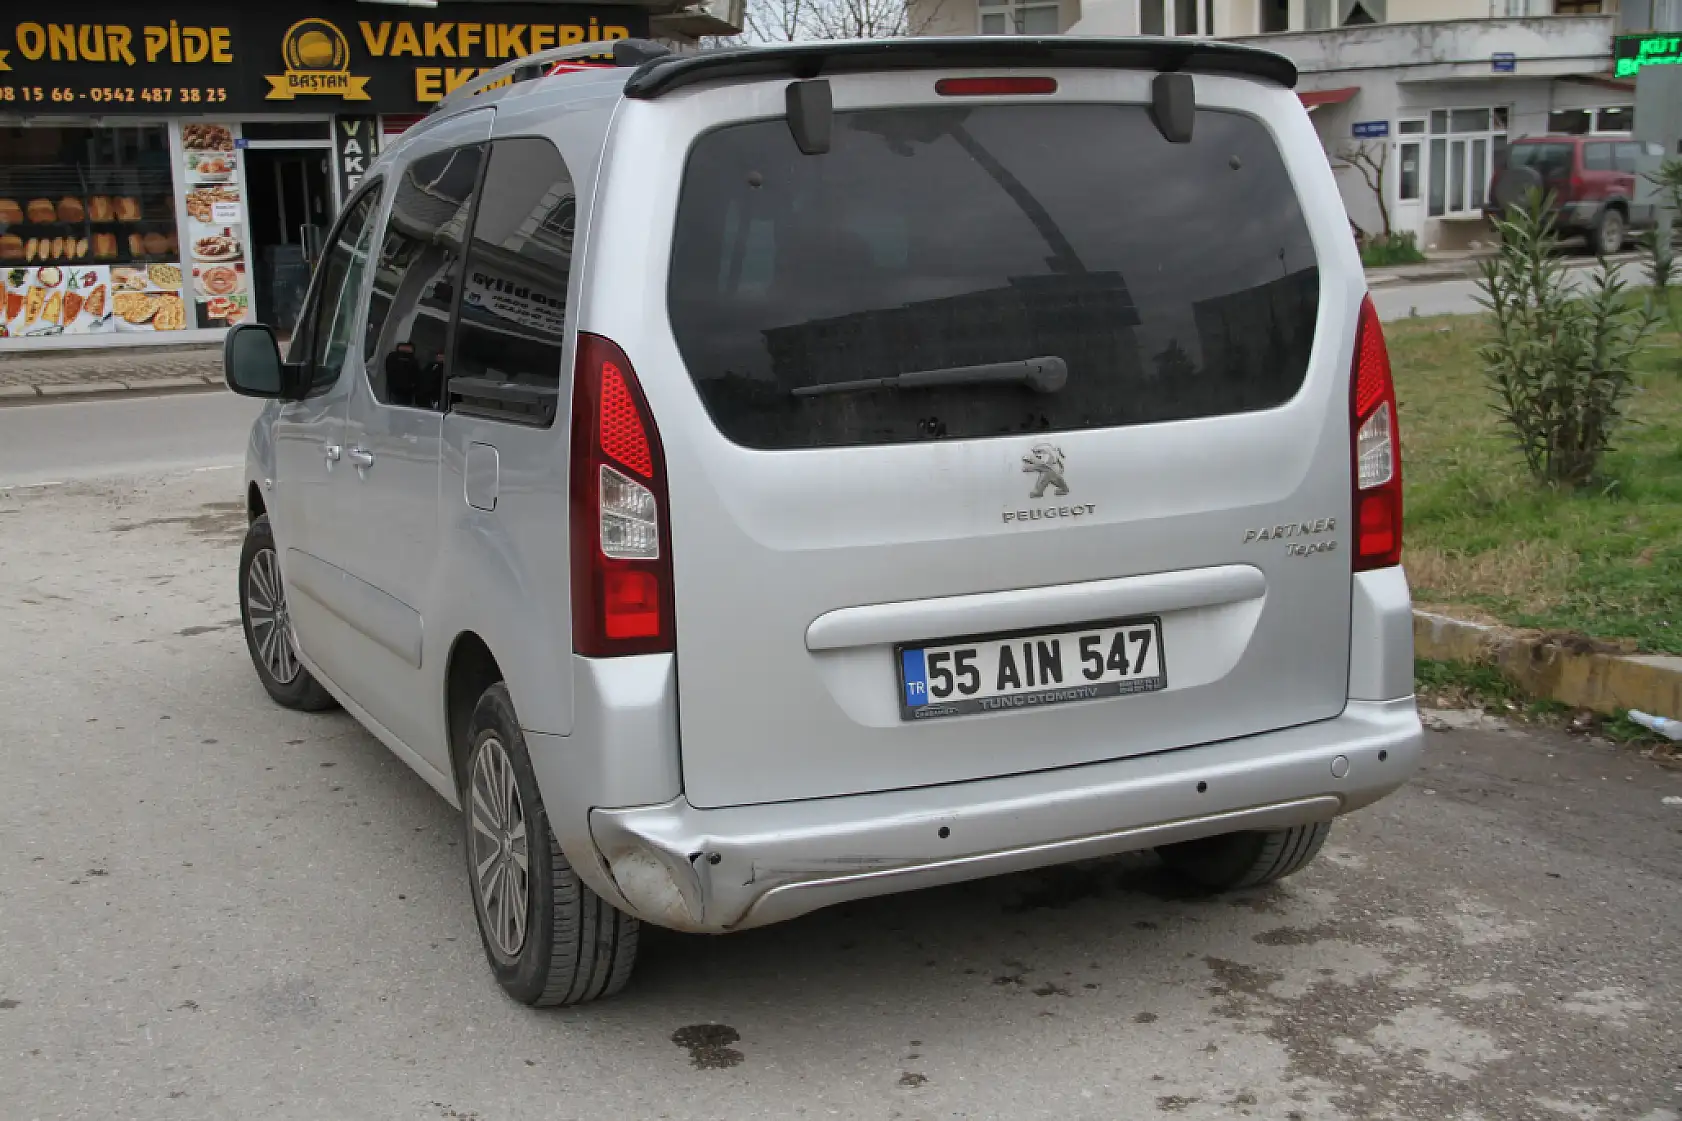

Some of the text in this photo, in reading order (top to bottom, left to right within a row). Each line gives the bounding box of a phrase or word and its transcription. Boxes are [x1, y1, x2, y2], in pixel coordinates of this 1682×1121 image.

[16, 19, 233, 66] ONUR PİDE
[22, 86, 44, 101] 15
[51, 87, 74, 102] 66
[90, 87, 135, 102] 0542
[141, 87, 172, 102] 487
[179, 87, 201, 102] 38
[206, 87, 227, 102] 25
[1002, 503, 1096, 523] PEUGEOT
[1243, 517, 1336, 544] PARTNER
[1285, 540, 1339, 557] Tepee
[928, 629, 1151, 698] 55 AIN 547
[908, 681, 926, 695] TR
